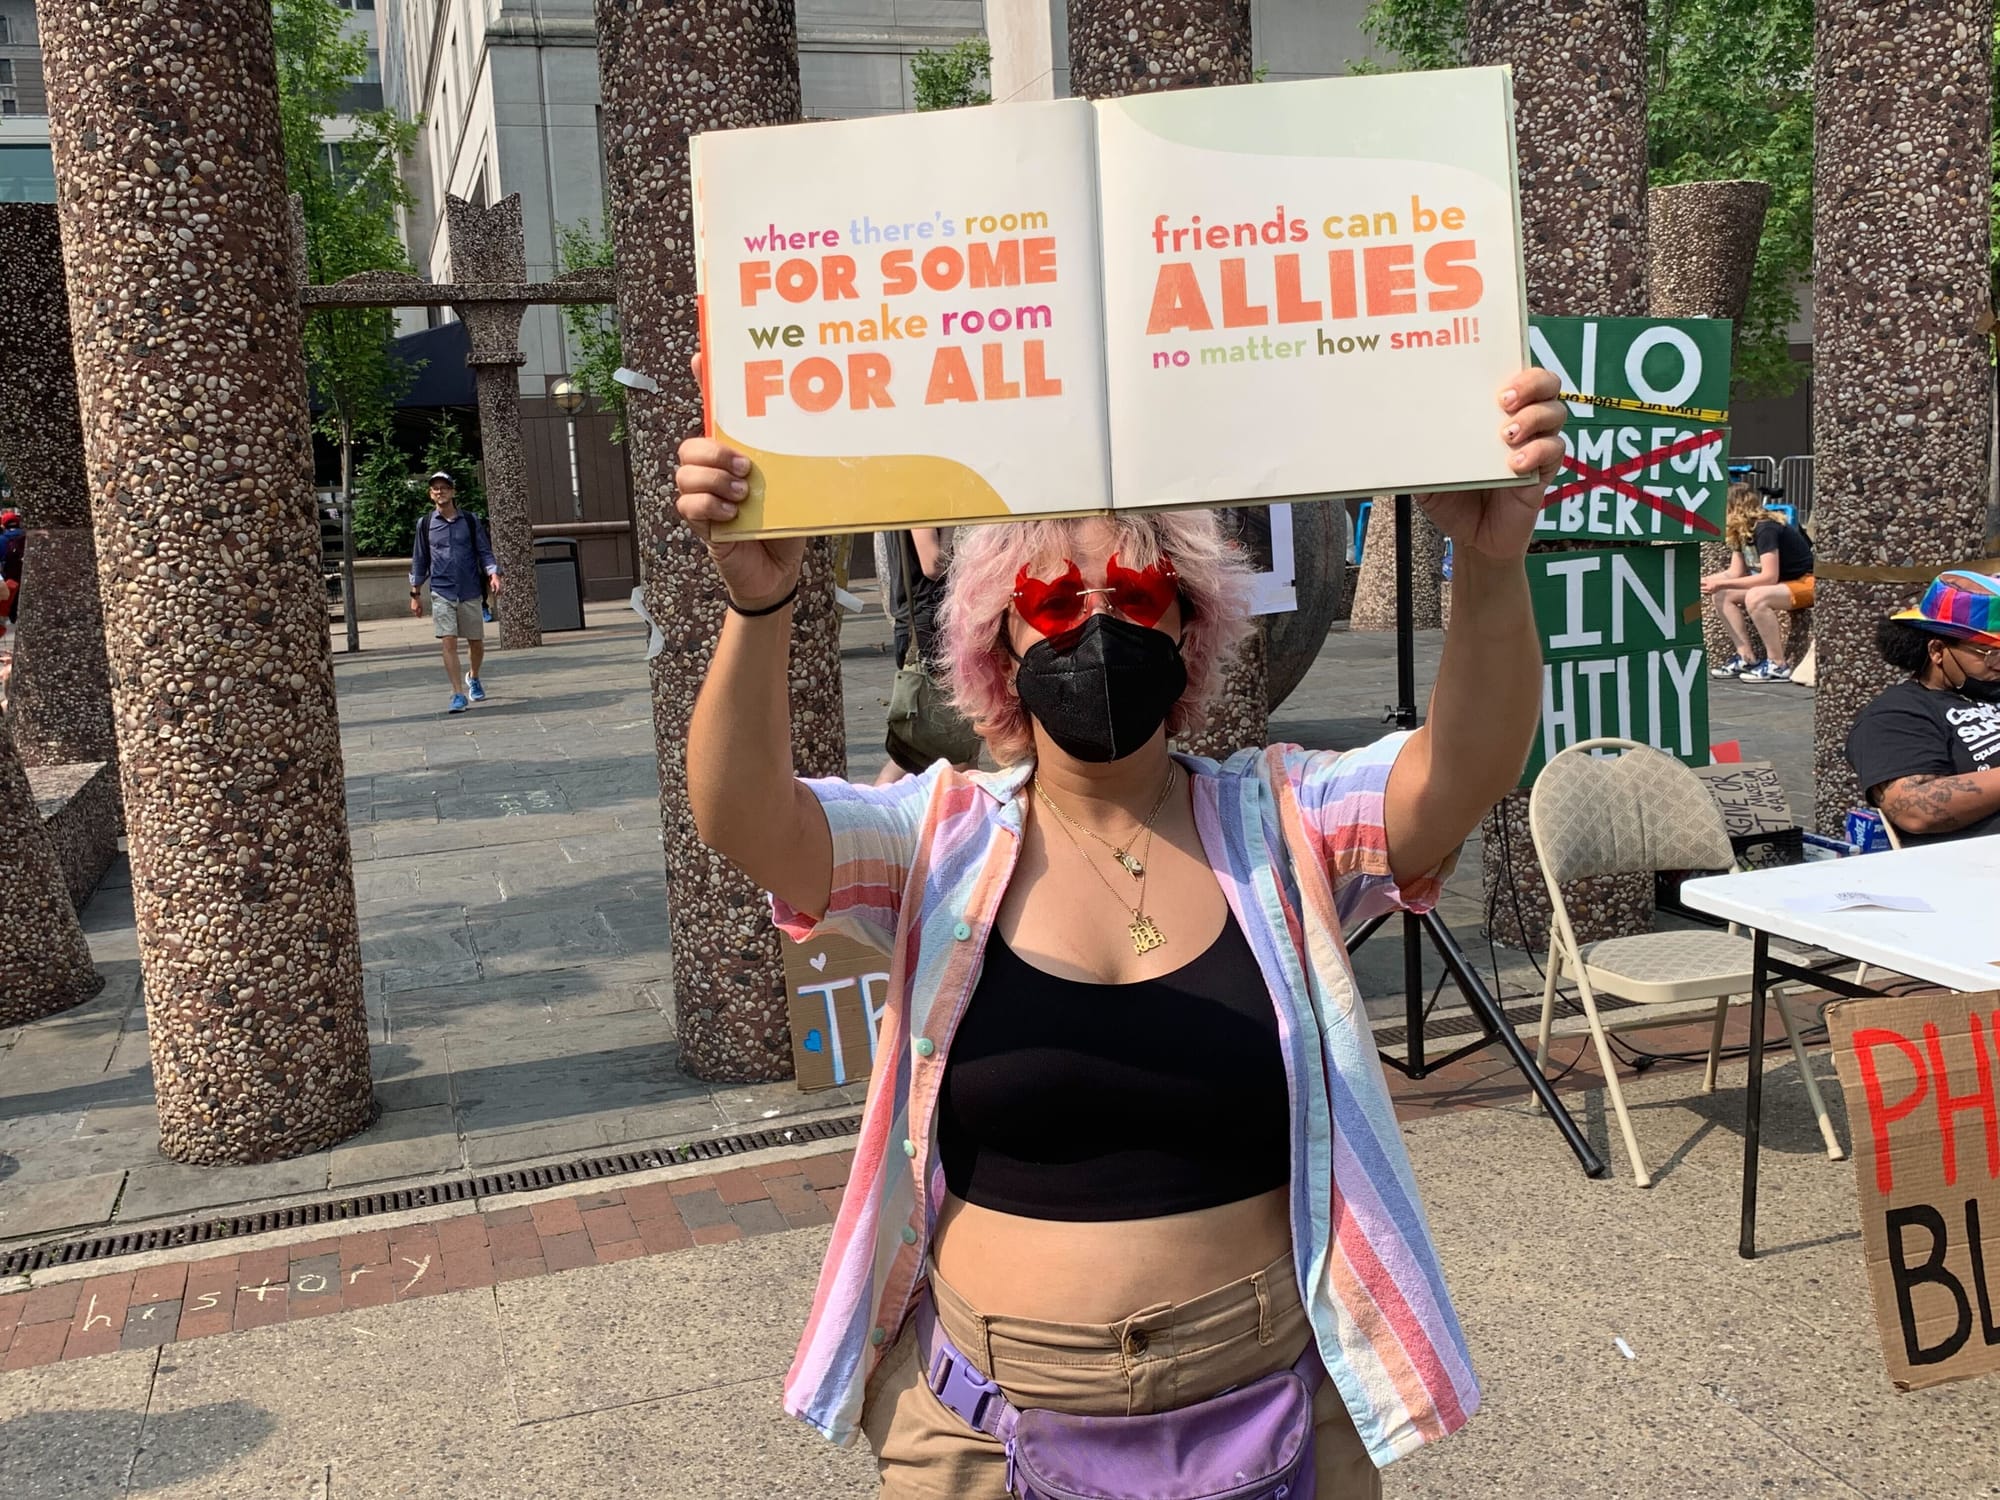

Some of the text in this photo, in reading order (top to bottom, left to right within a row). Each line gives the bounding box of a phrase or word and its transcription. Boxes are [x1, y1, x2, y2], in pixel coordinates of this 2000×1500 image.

[744, 210, 1049, 253] where there's room
[1151, 195, 1466, 253] friends can be
[739, 237, 1058, 307] FOR SOME
[1145, 239, 1484, 335] ALLIES
[748, 303, 1053, 350] we make room
[1152, 317, 1481, 369] no matter how small!
[744, 340, 1063, 417] FOR ALL
[1528, 322, 1702, 417] NO
[1556, 426, 1724, 483] OMS FOR
[1546, 549, 1676, 649] IN
[1542, 649, 1703, 764] HILLY
[1851, 1009, 2000, 1195] PH
[82, 1253, 432, 1332] history
